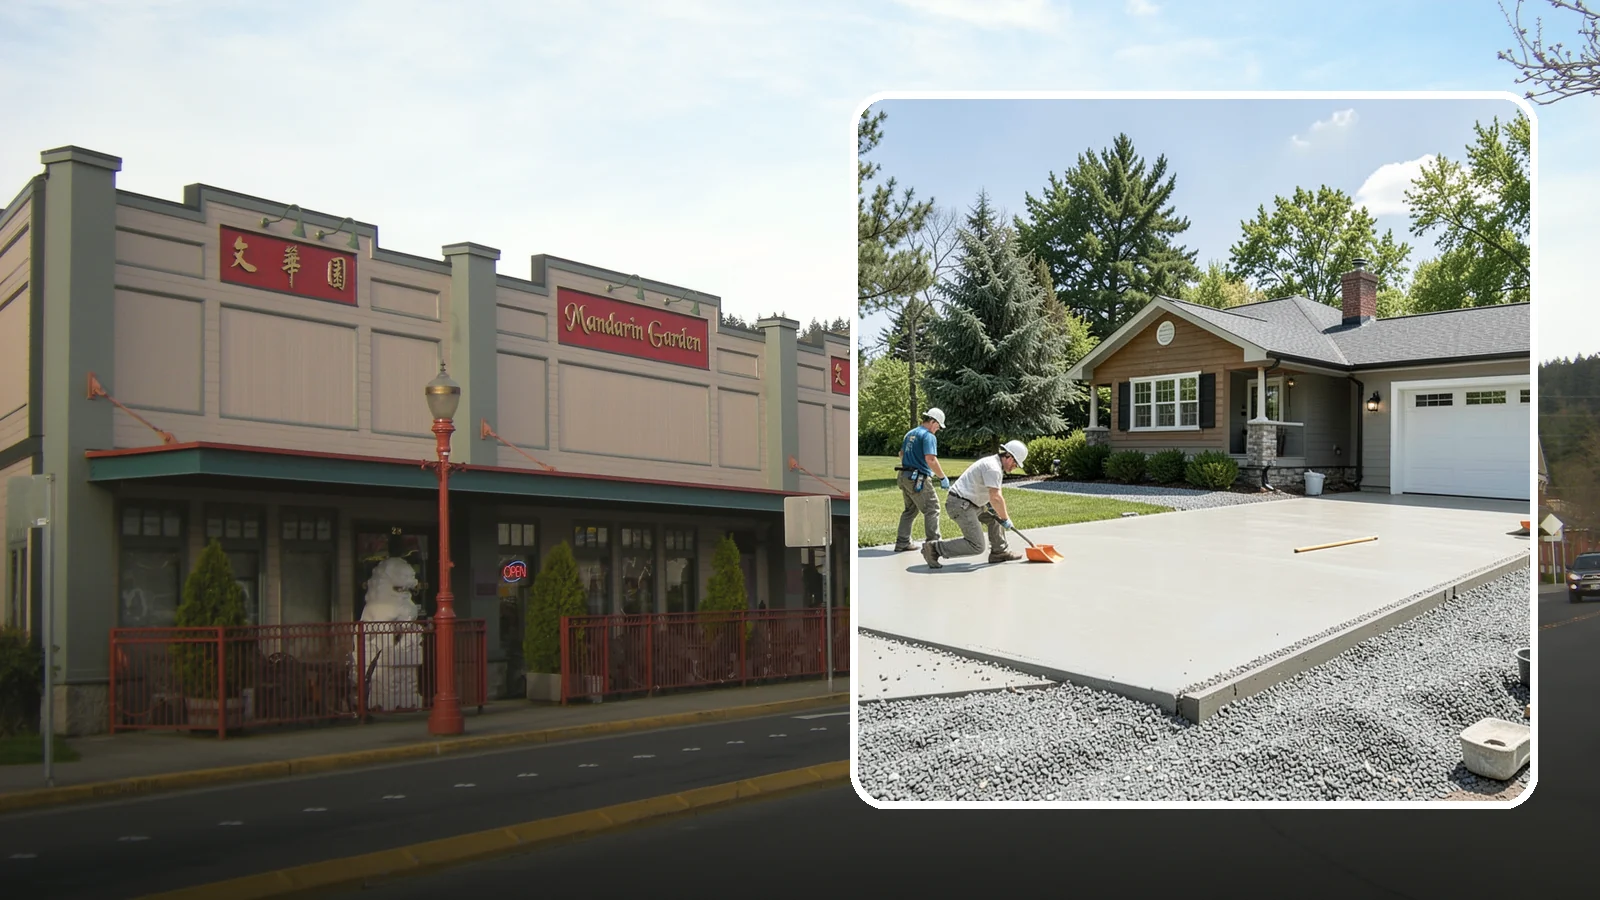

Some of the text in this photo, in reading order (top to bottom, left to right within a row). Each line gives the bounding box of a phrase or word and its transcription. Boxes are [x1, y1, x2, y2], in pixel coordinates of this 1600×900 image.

[230, 235, 346, 291] 文華園
[564, 302, 702, 352] Mandarin Garden
[503, 565, 527, 578] OPEN
